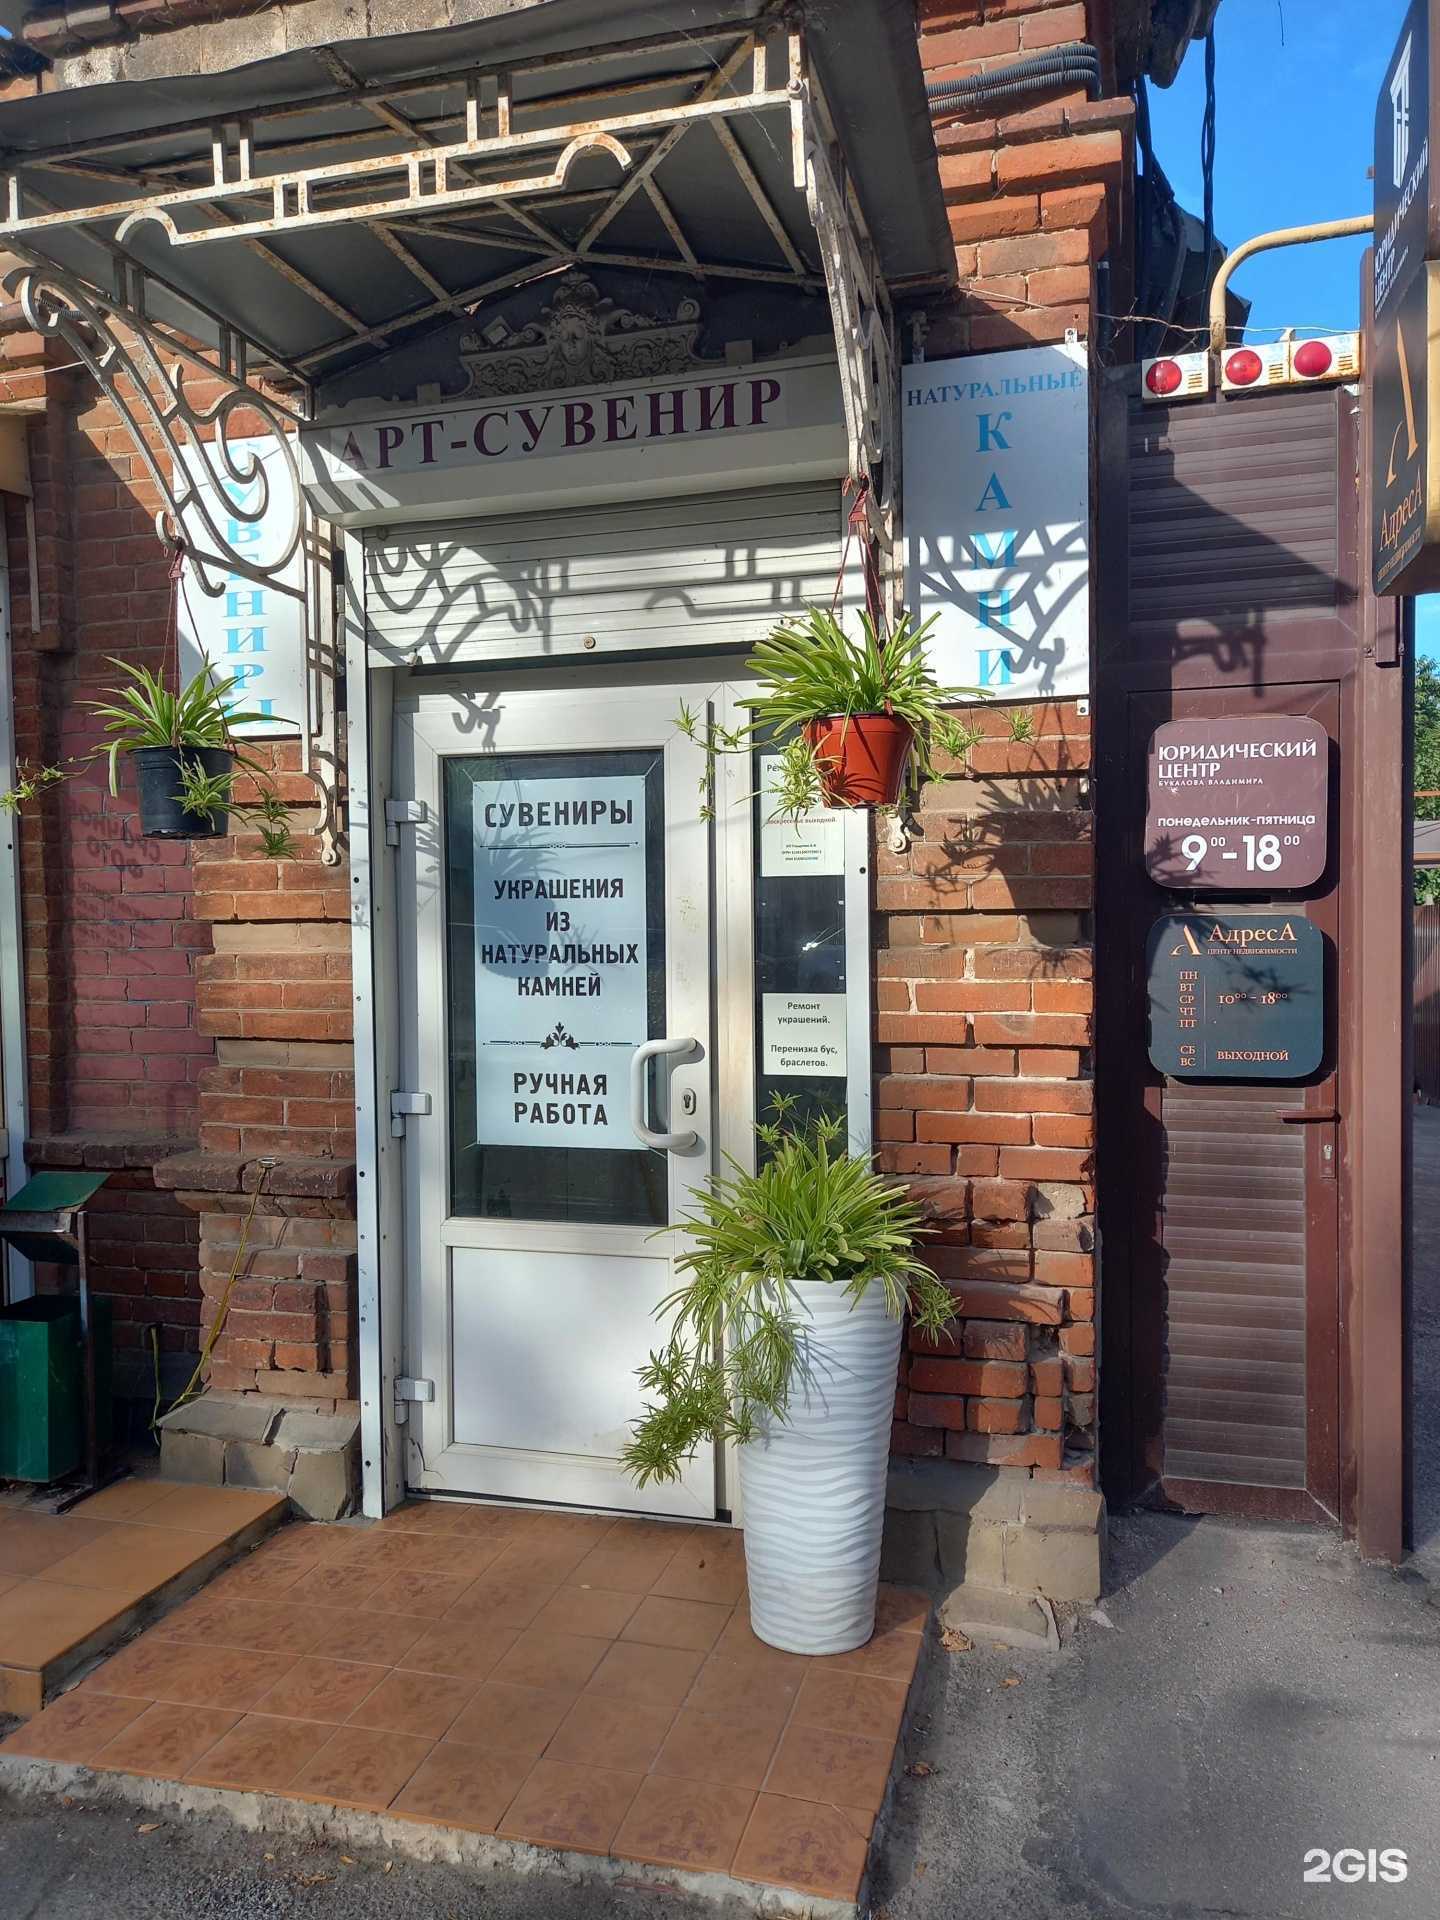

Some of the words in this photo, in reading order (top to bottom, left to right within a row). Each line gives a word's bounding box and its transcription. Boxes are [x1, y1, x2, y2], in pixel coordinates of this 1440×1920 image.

[906, 369, 1083, 407] НАТУРАЛЬНЫЕ
[334, 377, 781, 475] АРТ-СУВЕНИР
[1158, 738, 1317, 761] ЮРИДИЧЕСКИЙ
[1158, 763, 1221, 779] ЦЕНТР
[484, 799, 633, 828] СУВЕНИРЫ
[493, 877, 624, 900] УКРАШЕНИЯ
[546, 911, 571, 932] ИЗ
[1207, 922, 1297, 948] АдресА
[481, 943, 639, 964] НАТУРАЛЬНЫХ
[1179, 971, 1198, 980] ПН
[518, 972, 601, 996] КАМНЕЙ
[1179, 983, 1195, 992] ВТ
[787, 1001, 821, 1010] Ремонт
[1179, 995, 1195, 1004] СР
[1179, 1007, 1196, 1016] ЧТ
[777, 1015, 831, 1024] украшений.
[1179, 1019, 1197, 1028] ПТ
[770, 1044, 818, 1053] Перенизка
[820, 1044, 838, 1055] бус,
[1180, 1045, 1196, 1054] СБ
[1216, 1049, 1289, 1062] ВЫХОДНОЙ
[780, 1057, 828, 1068] браслетов.
[1180, 1057, 1196, 1067] ВС
[513, 1072, 608, 1096] РУЧНАЯ
[514, 1102, 608, 1126] РАБОТА
